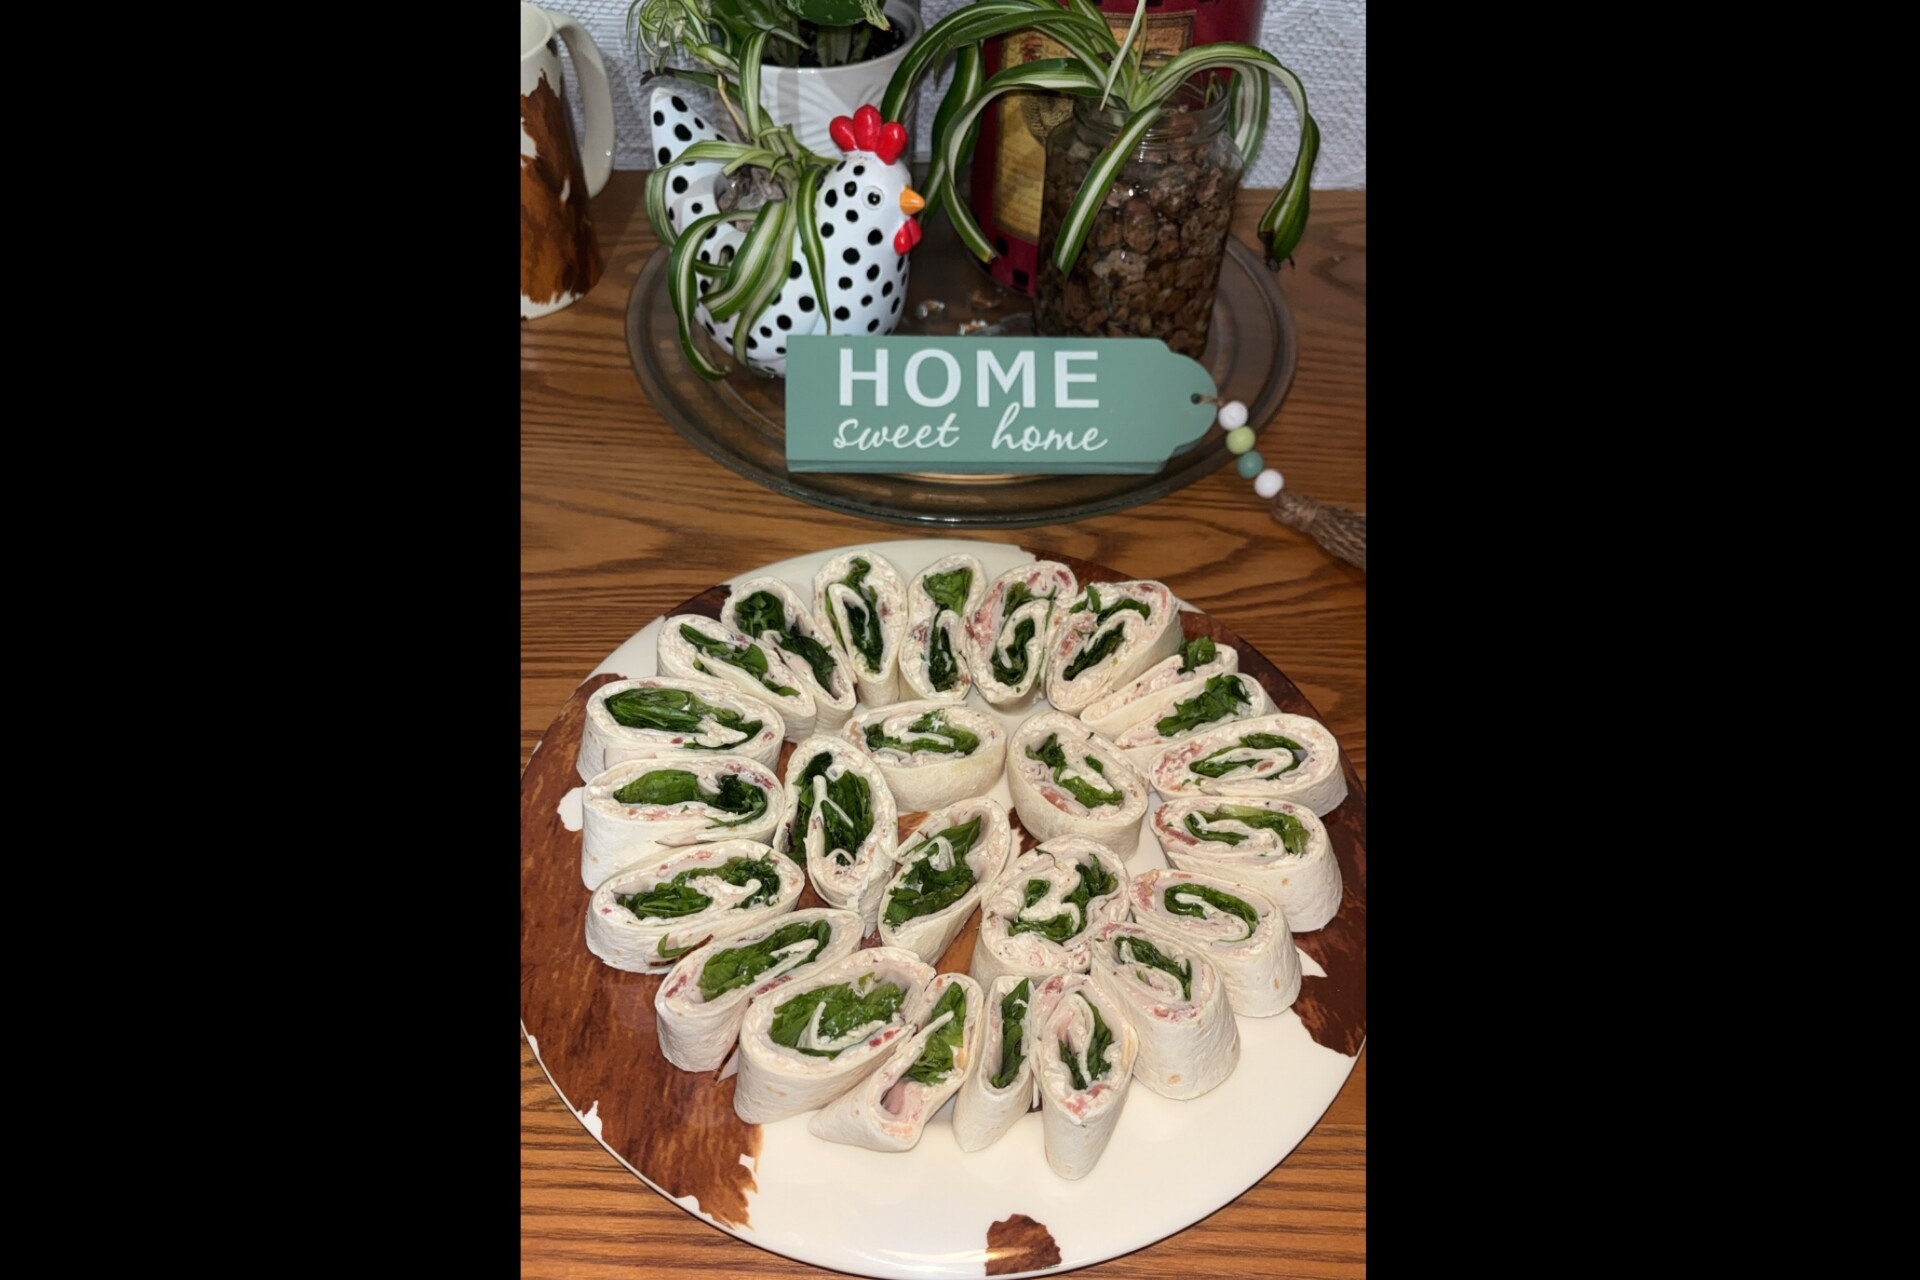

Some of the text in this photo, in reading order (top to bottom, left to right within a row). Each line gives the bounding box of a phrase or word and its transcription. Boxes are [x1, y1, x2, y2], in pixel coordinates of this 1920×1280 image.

[839, 348, 1100, 408] HOME
[833, 402, 1109, 452] sweet home
